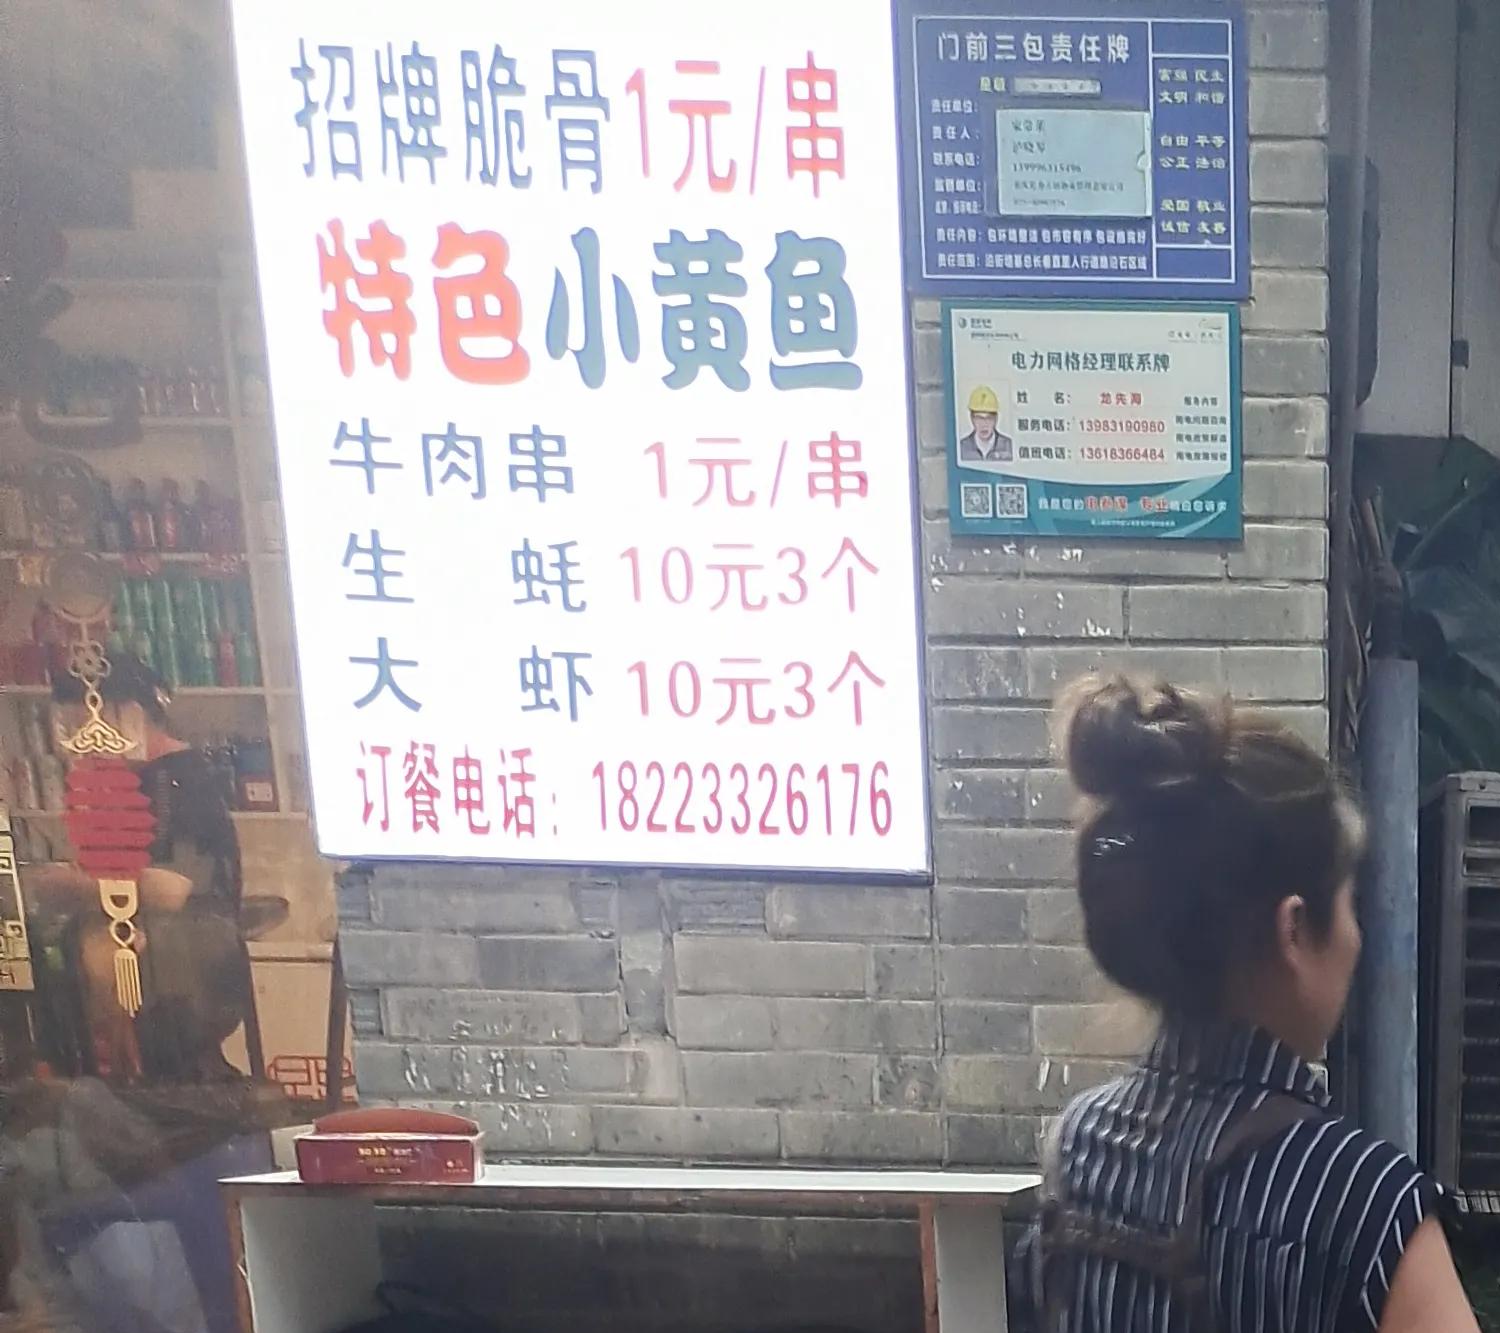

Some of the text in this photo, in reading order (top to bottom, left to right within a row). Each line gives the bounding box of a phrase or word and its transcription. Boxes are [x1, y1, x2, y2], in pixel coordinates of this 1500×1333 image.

[937, 32, 1130, 63] 门前三包责任牌
[316, 218, 863, 392] 特色小黄鱼
[1011, 352, 1170, 372] 电力网格经理联系牌
[329, 417, 868, 508] 牛肉串 1元/串
[620, 537, 879, 613] 10元3个
[628, 651, 885, 726] 10元3个
[592, 760, 892, 837] 18223326176
